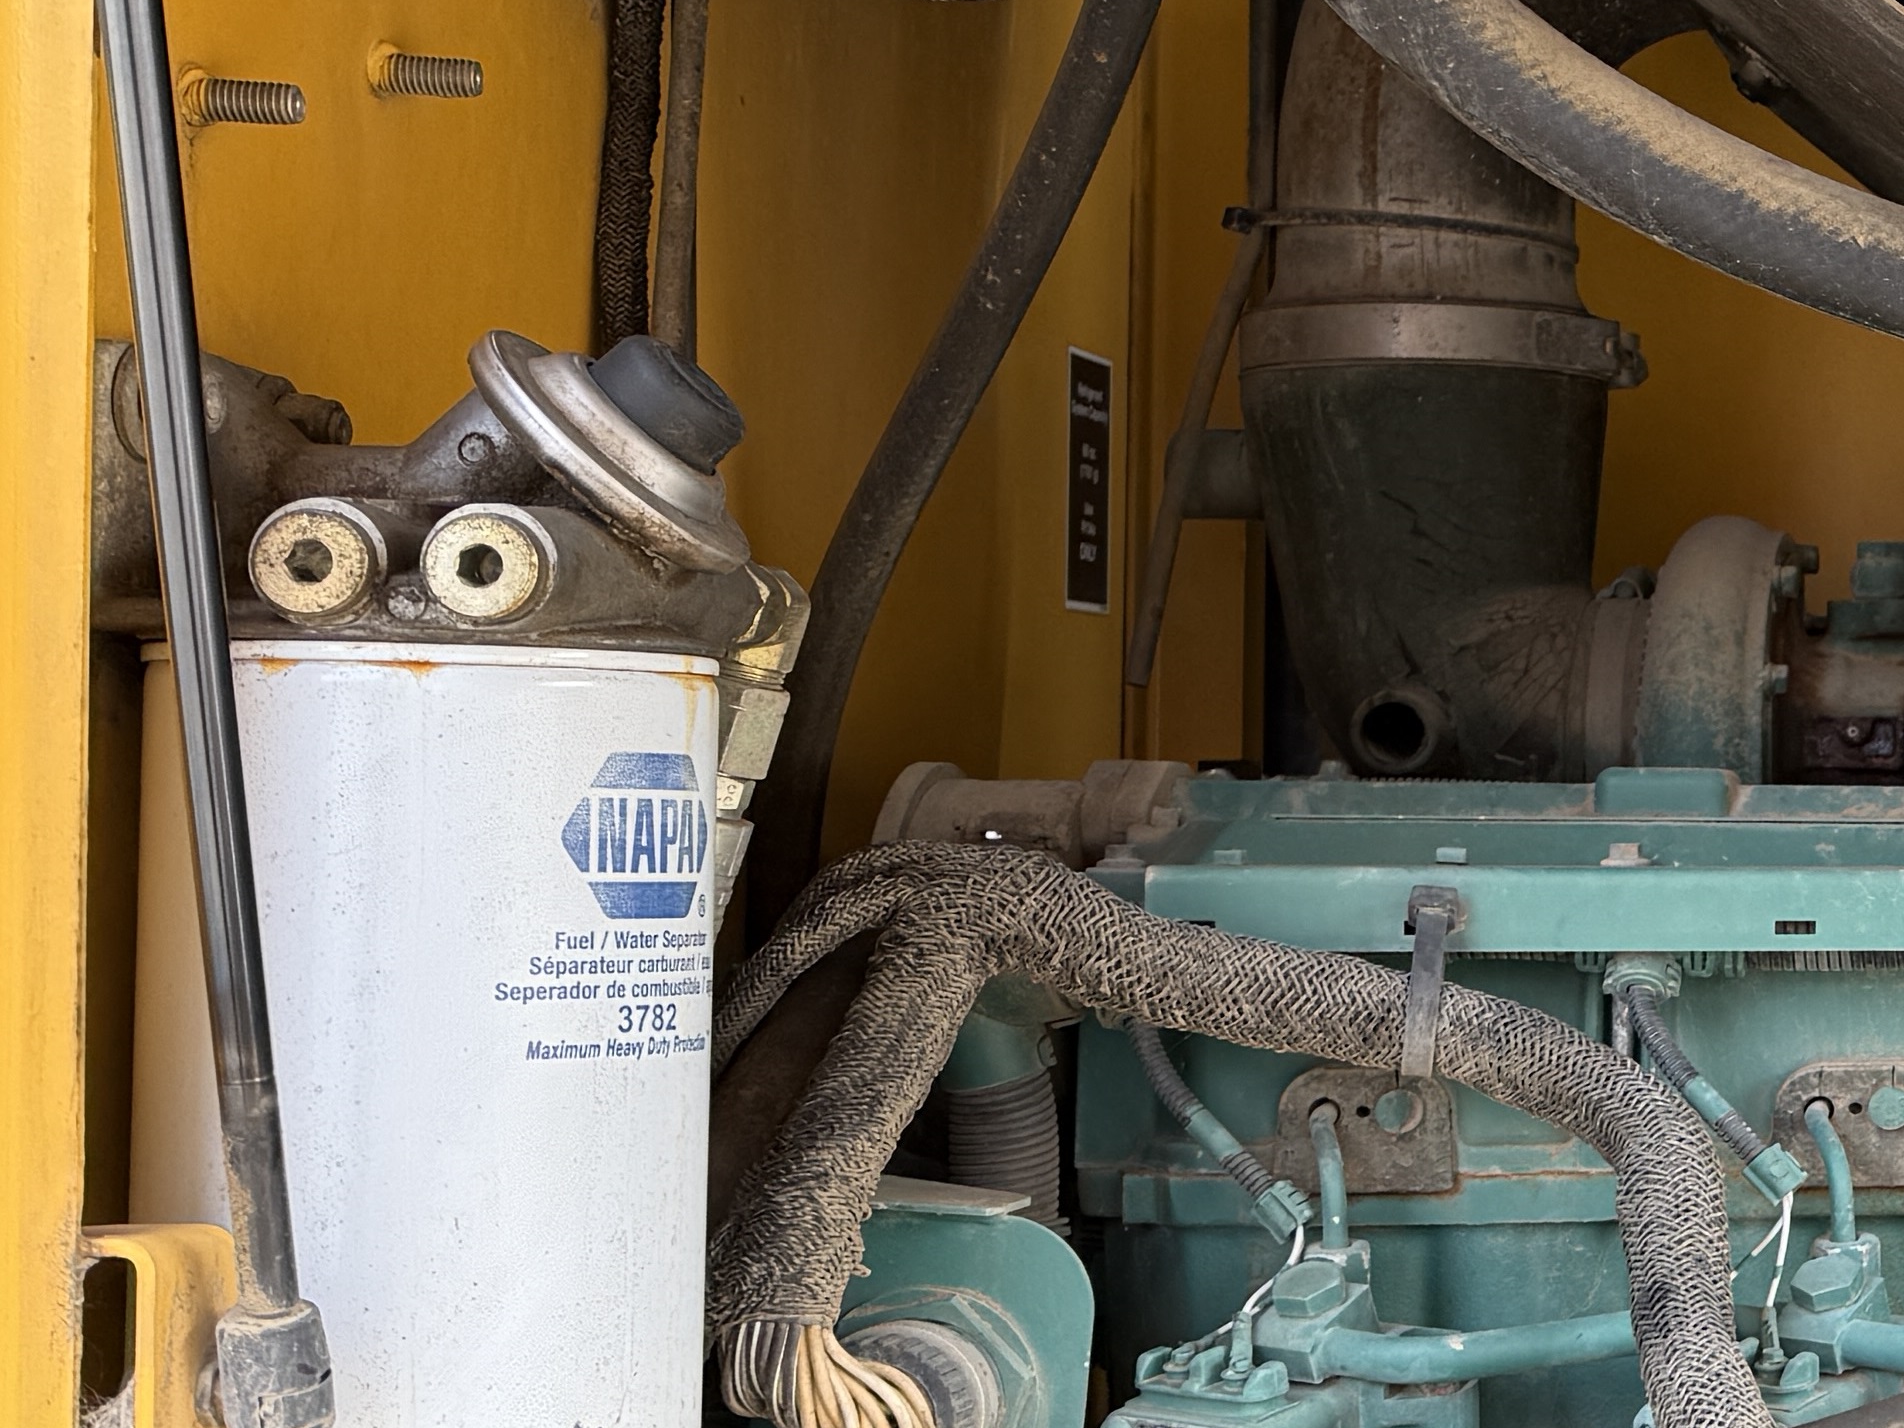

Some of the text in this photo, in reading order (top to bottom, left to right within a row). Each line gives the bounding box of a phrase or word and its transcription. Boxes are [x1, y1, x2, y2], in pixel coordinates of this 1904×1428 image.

[597, 798, 694, 874] NAPA
[555, 931, 594, 950] Fuel
[614, 930, 658, 949] Water
[529, 956, 634, 979] Séparateur
[494, 980, 600, 1005] Seperador
[606, 980, 626, 998] de
[617, 1003, 677, 1033] 3782
[526, 1039, 601, 1060] Maximum
[606, 1037, 645, 1061] Heavy
[647, 1035, 671, 1058] Duty
